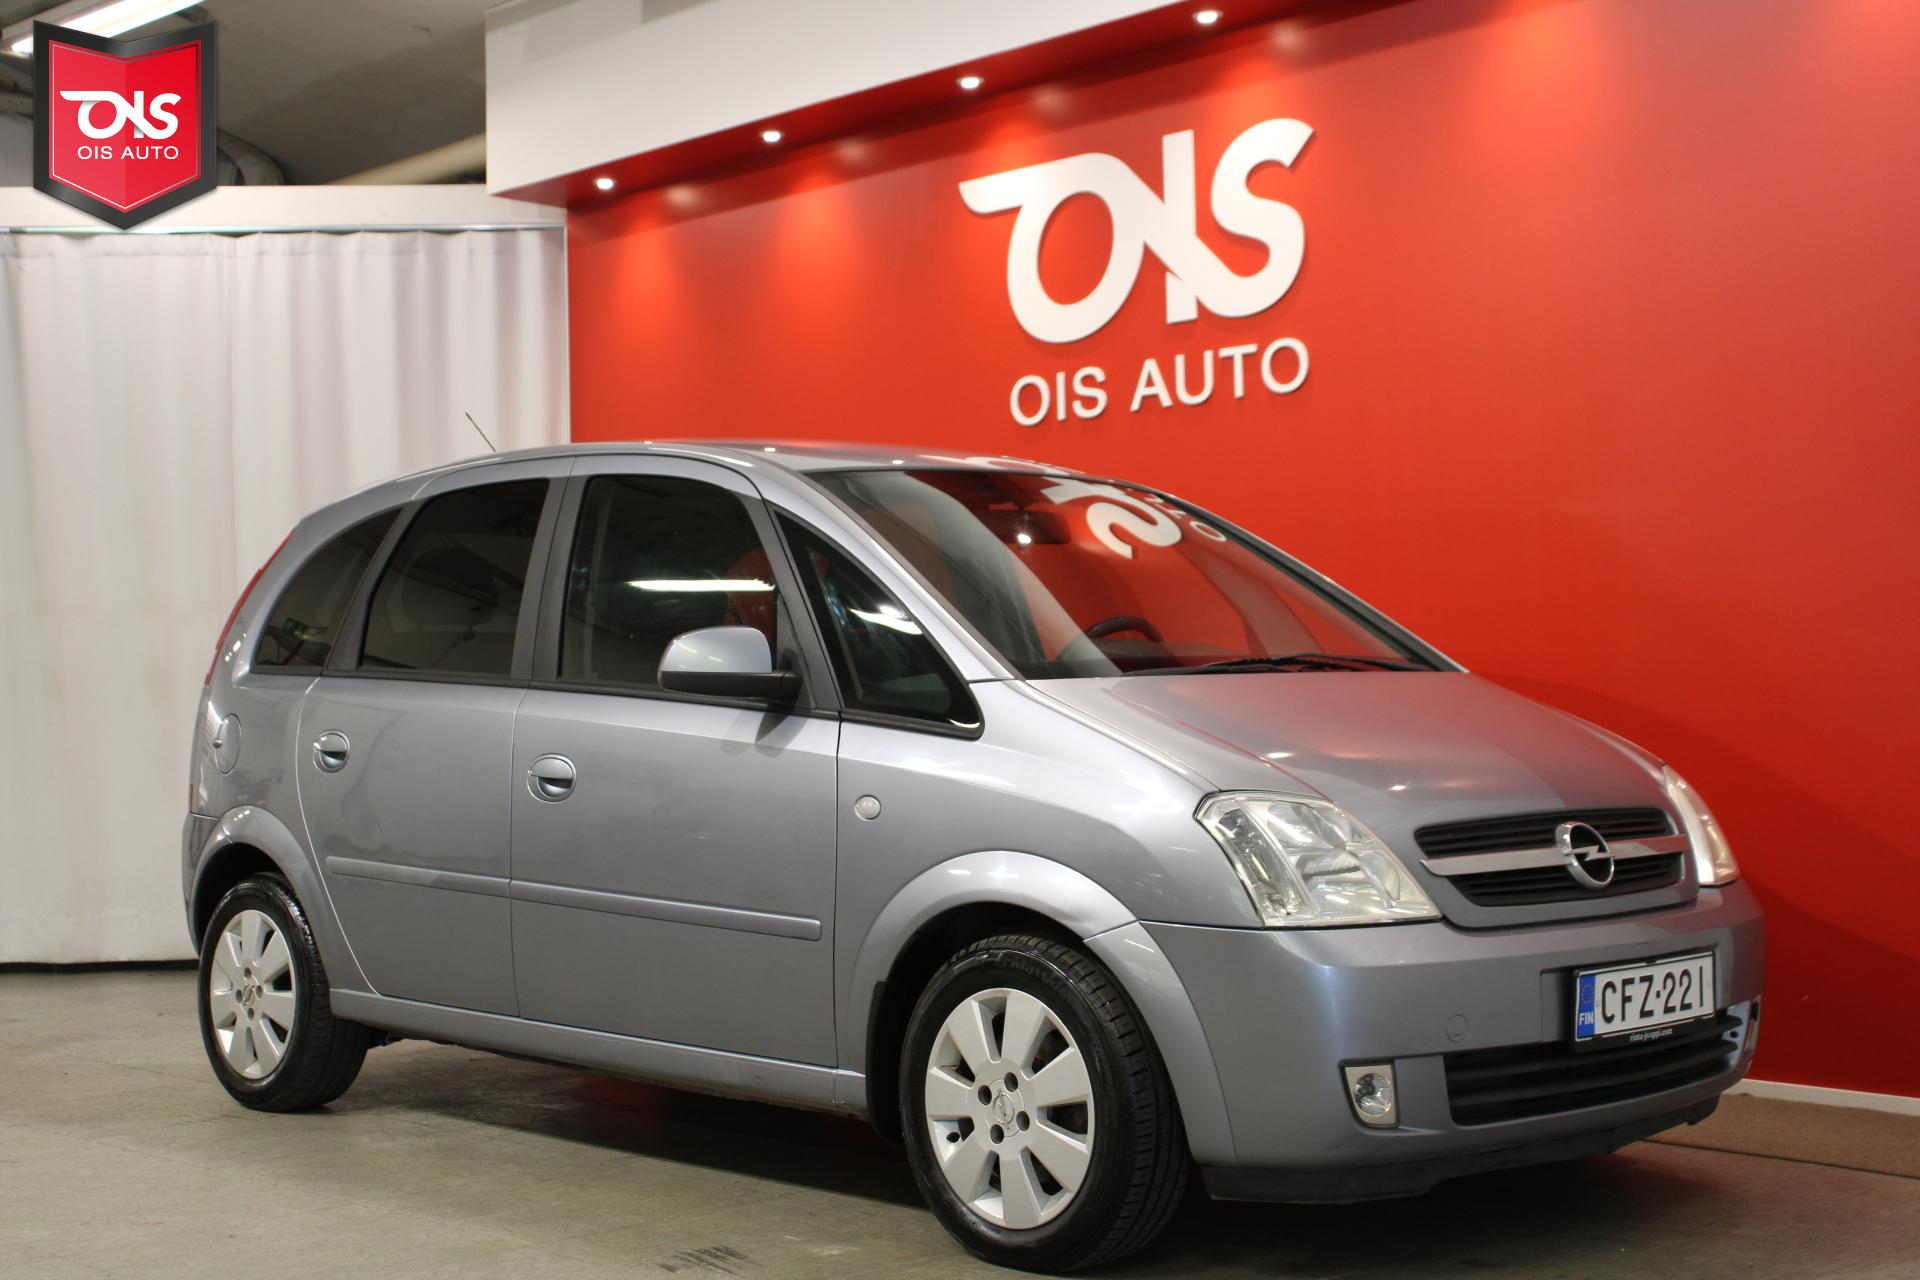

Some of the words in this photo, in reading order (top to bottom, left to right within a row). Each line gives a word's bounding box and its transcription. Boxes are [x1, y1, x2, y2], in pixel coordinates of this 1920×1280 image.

[958, 118, 1314, 343] OIS
[1010, 366, 1108, 426] OIS
[1130, 337, 1310, 412] AUTO
[1579, 1011, 1595, 1026] FIN
[1601, 966, 1704, 1025] CFZ-221
